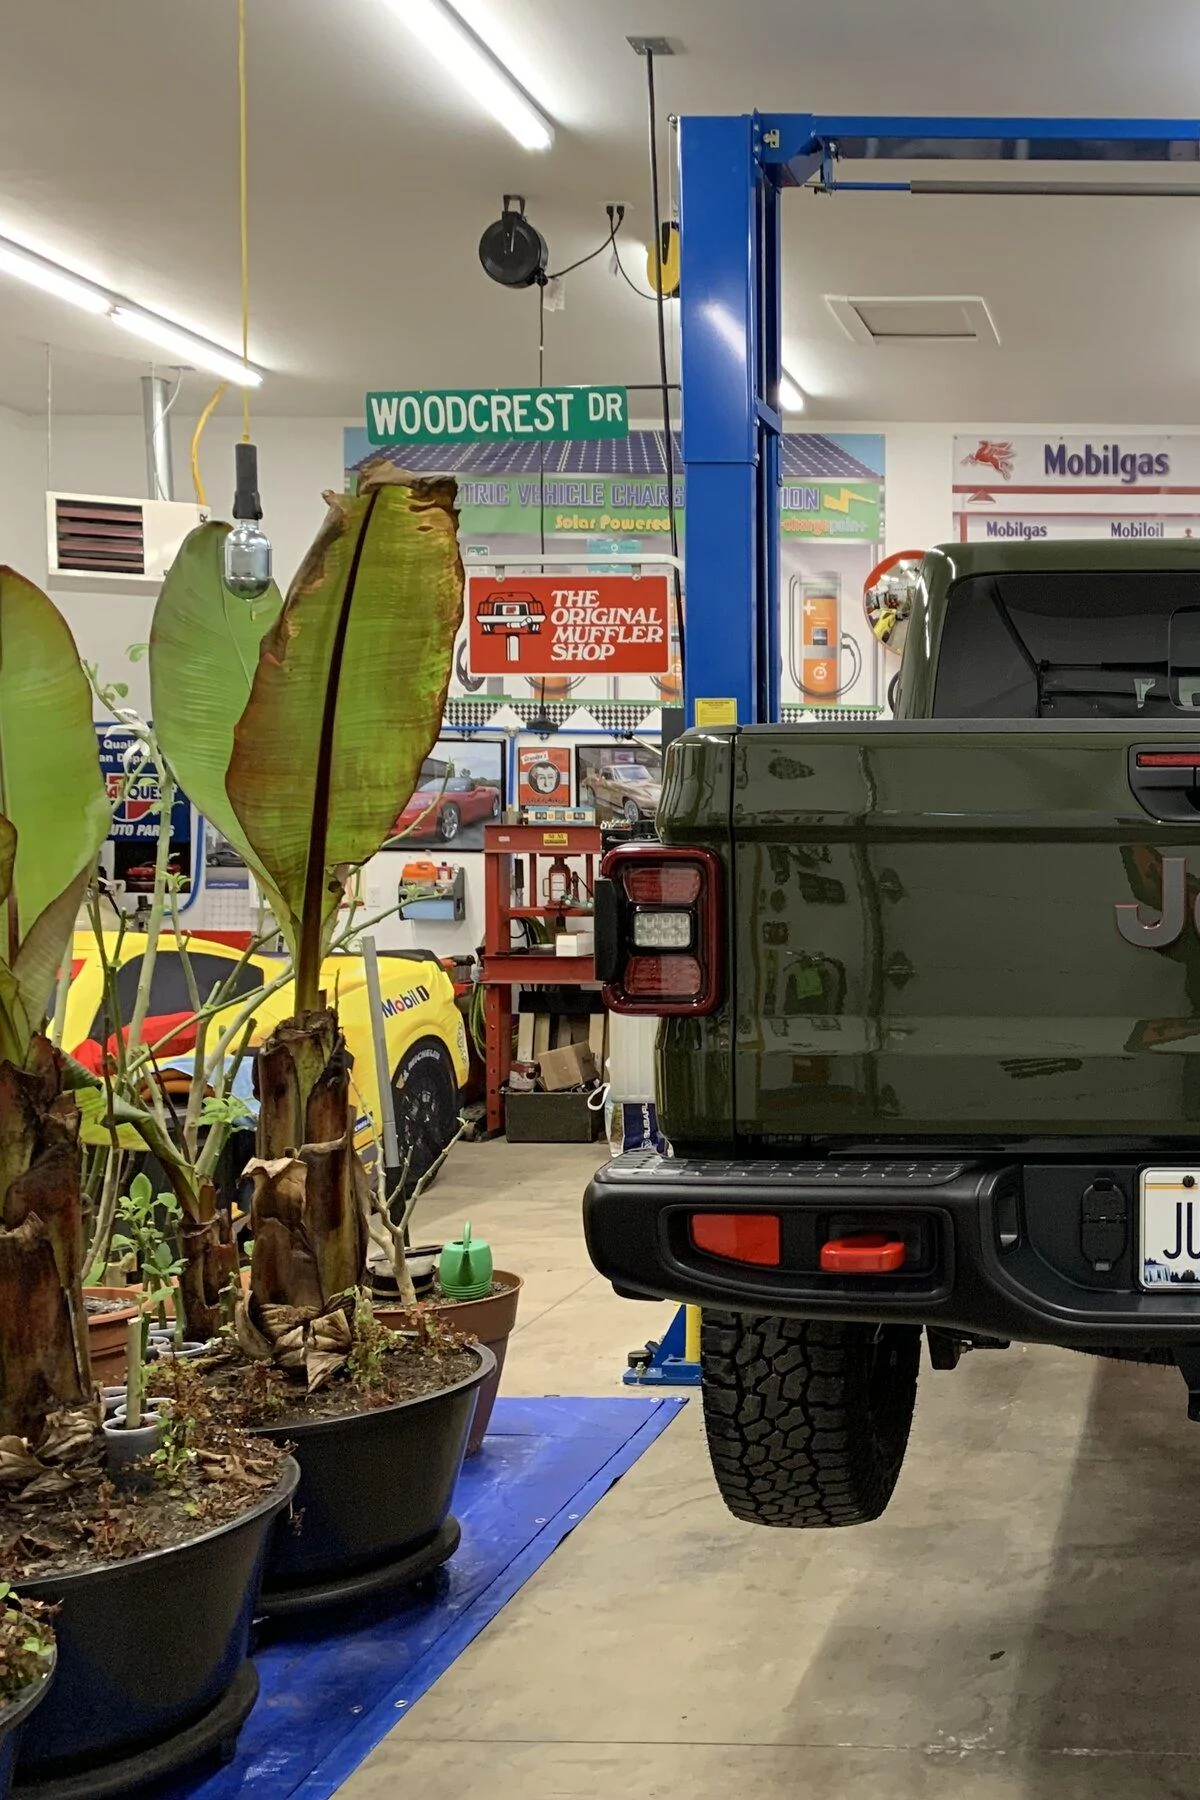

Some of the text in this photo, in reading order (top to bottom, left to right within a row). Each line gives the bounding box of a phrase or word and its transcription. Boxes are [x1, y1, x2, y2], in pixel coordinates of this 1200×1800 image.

[371, 392, 623, 436] WOODCREST DR
[1044, 443, 1170, 484] Mobilgas
[517, 482, 604, 507] VEHICLE
[554, 514, 672, 531] Solar Powered
[986, 521, 1048, 540] Mobilgas
[1111, 522, 1164, 538] Mobiloil
[551, 590, 600, 608] THE
[550, 607, 663, 625] ORIGINAL
[551, 626, 664, 644] MUFFLER
[550, 644, 616, 661] SHOP
[110, 824, 175, 837] UTO PARS
[381, 989, 420, 1018] Mobil
